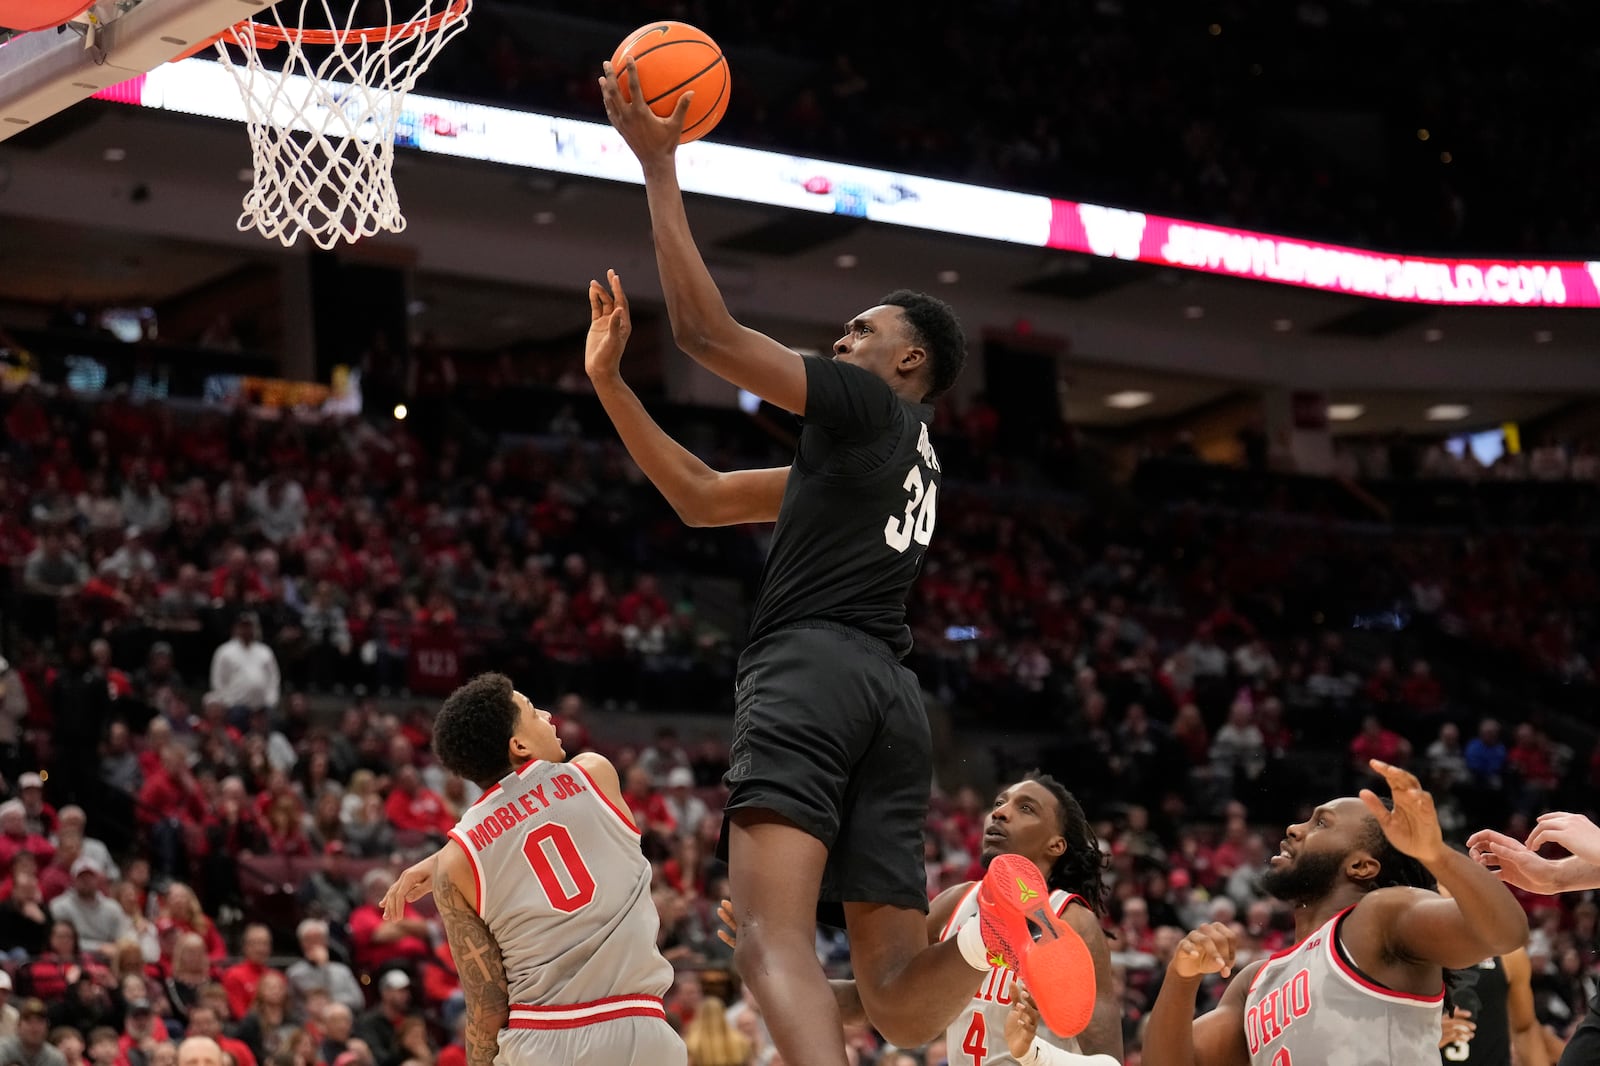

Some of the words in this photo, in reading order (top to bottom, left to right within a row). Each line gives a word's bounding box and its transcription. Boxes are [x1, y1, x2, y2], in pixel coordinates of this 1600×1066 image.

[465, 783, 550, 852] MOBLEY
[552, 773, 588, 801] JR.
[520, 820, 598, 914] 0
[961, 1011, 988, 1066] 4
[1246, 967, 1312, 1057] OHIO
